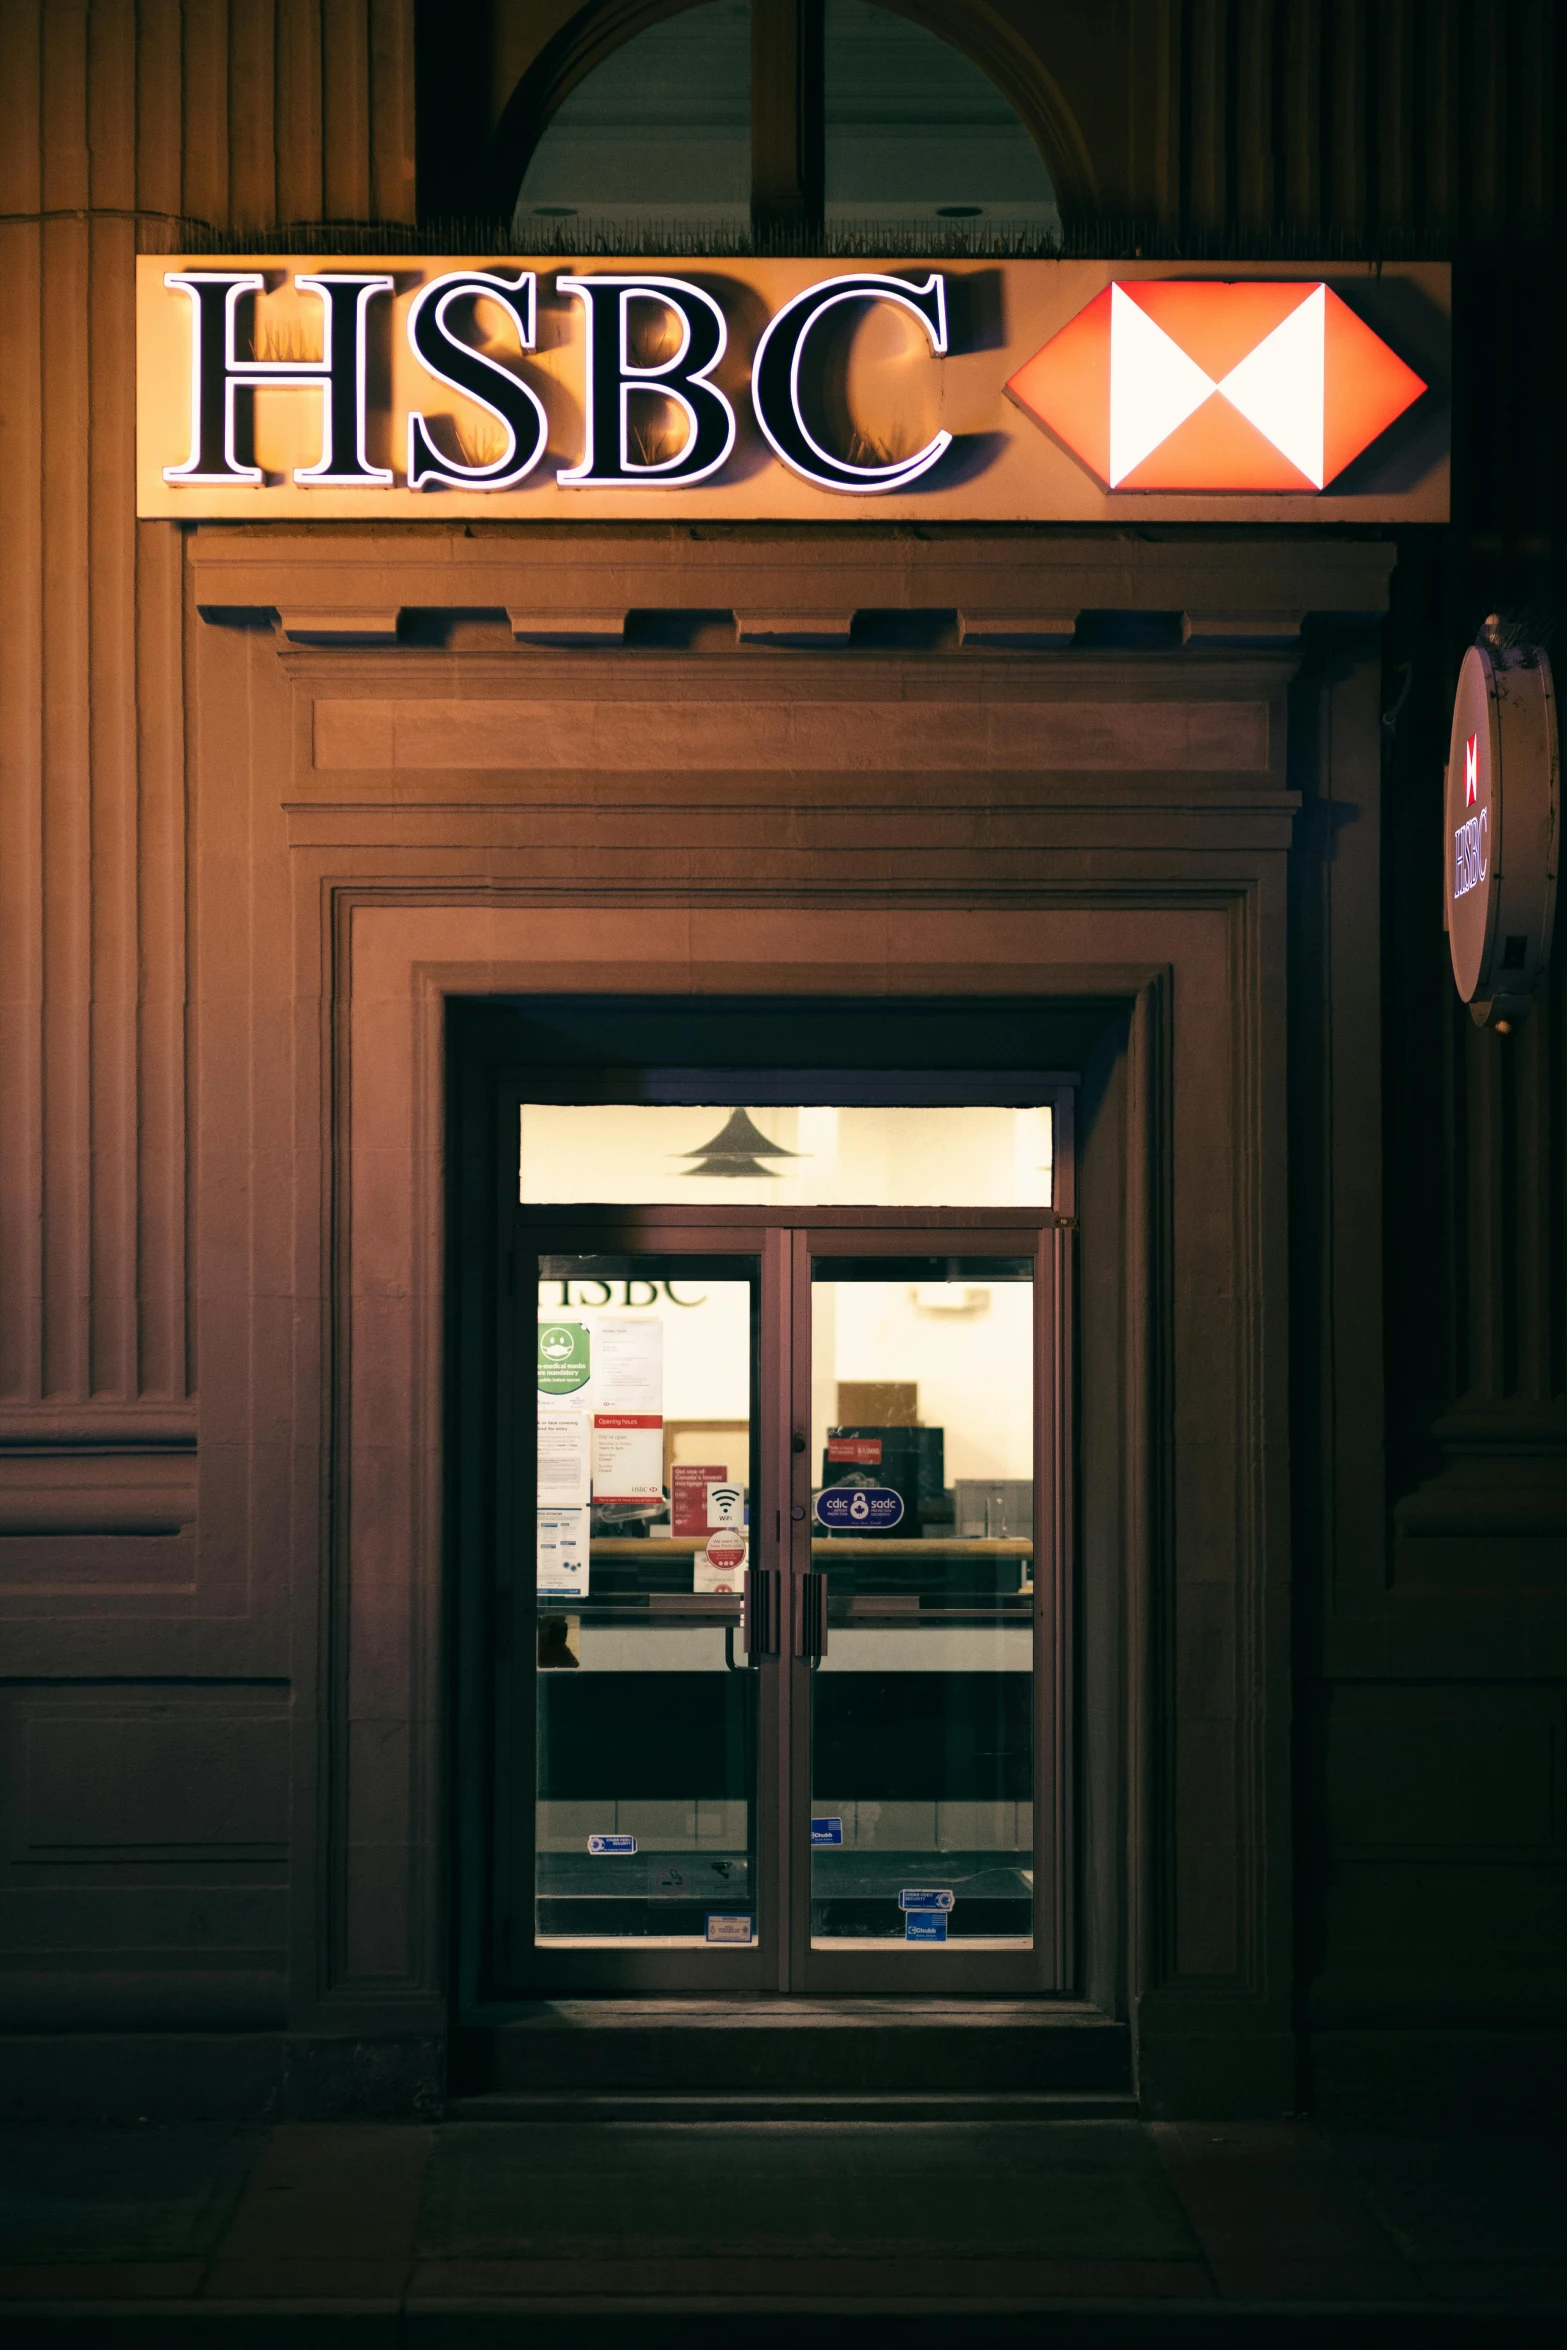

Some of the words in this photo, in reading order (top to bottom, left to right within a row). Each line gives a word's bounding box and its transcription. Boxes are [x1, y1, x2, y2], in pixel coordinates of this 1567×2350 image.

[163, 270, 953, 495] HSBC
[1455, 807, 1488, 899] HSBC
[547, 1369, 579, 1377] mandatory
[598, 1417, 621, 1426] Opening
[826, 1498, 848, 1509] cdic
[871, 1498, 896, 1509] sadc
